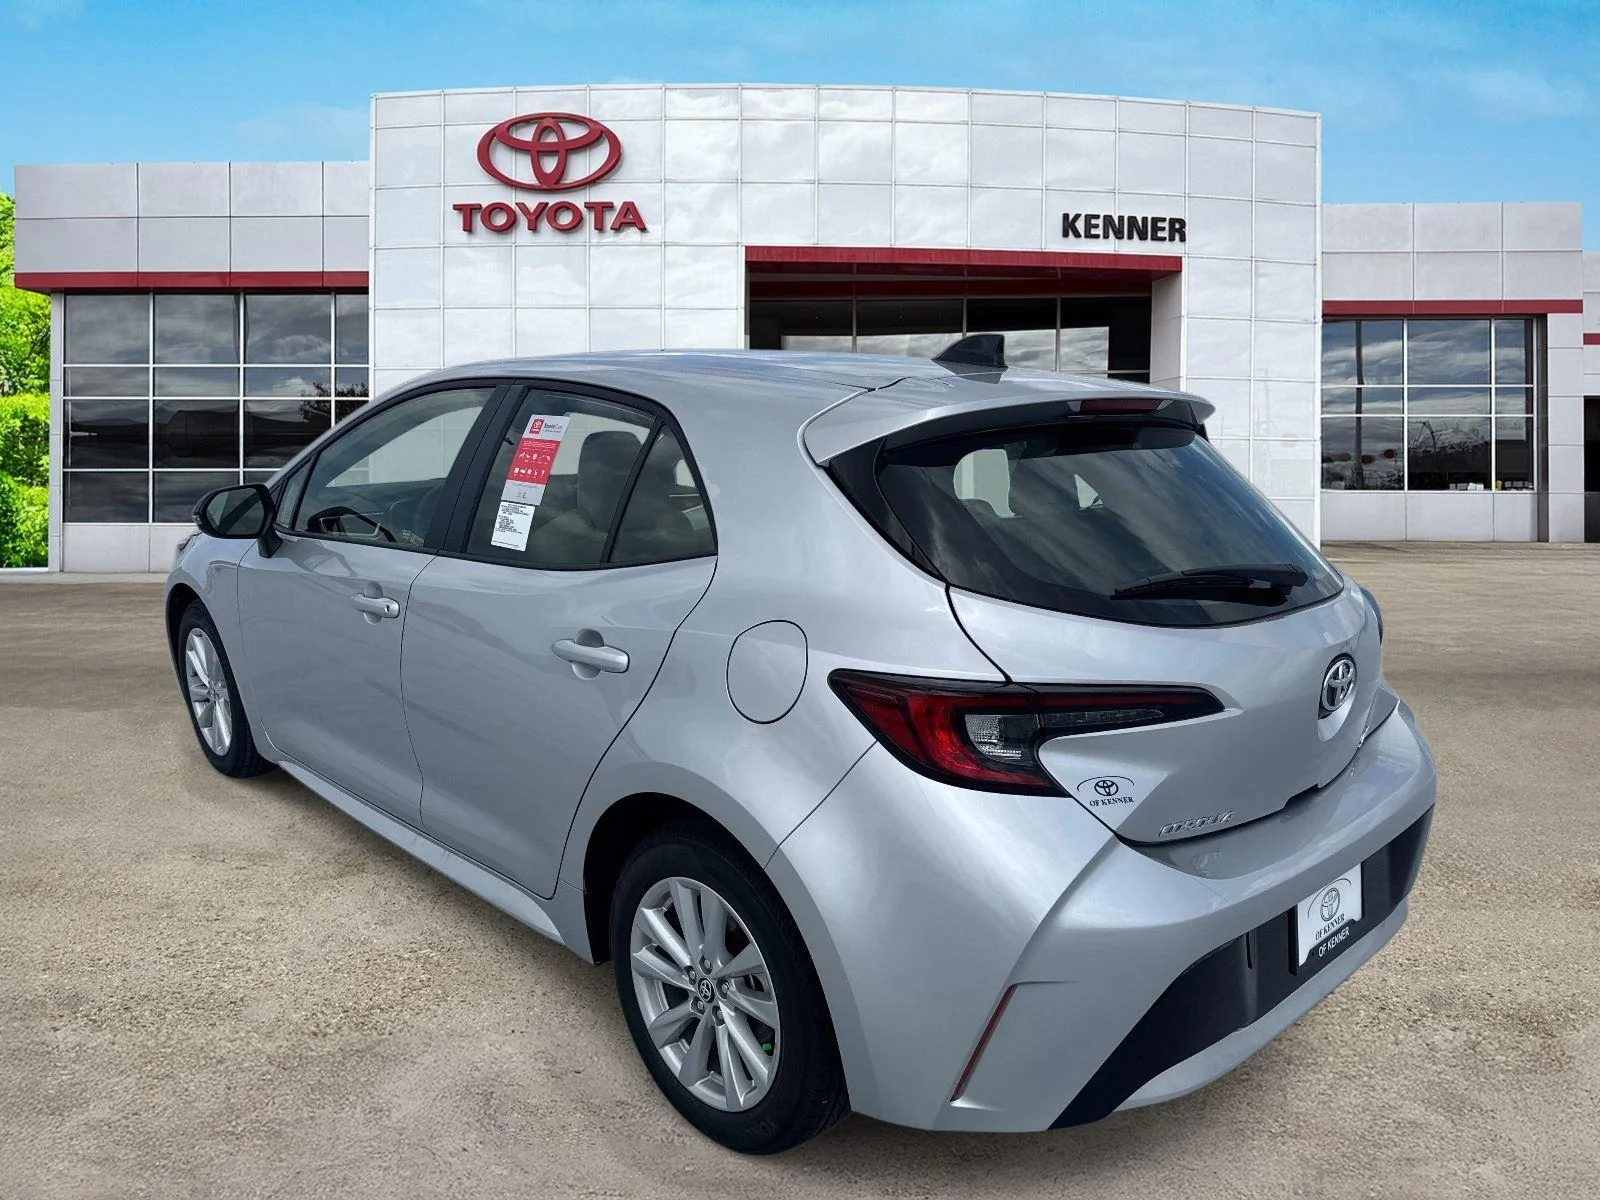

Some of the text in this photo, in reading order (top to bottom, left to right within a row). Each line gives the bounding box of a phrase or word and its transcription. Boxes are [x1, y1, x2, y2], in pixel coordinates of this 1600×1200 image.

[453, 201, 648, 232] TOYOTA
[1062, 213, 1187, 242] KENNER
[1089, 796, 1135, 807] OF KENNER
[1315, 913, 1345, 941] OF KENNER
[1318, 926, 1350, 957] OF KENNER
